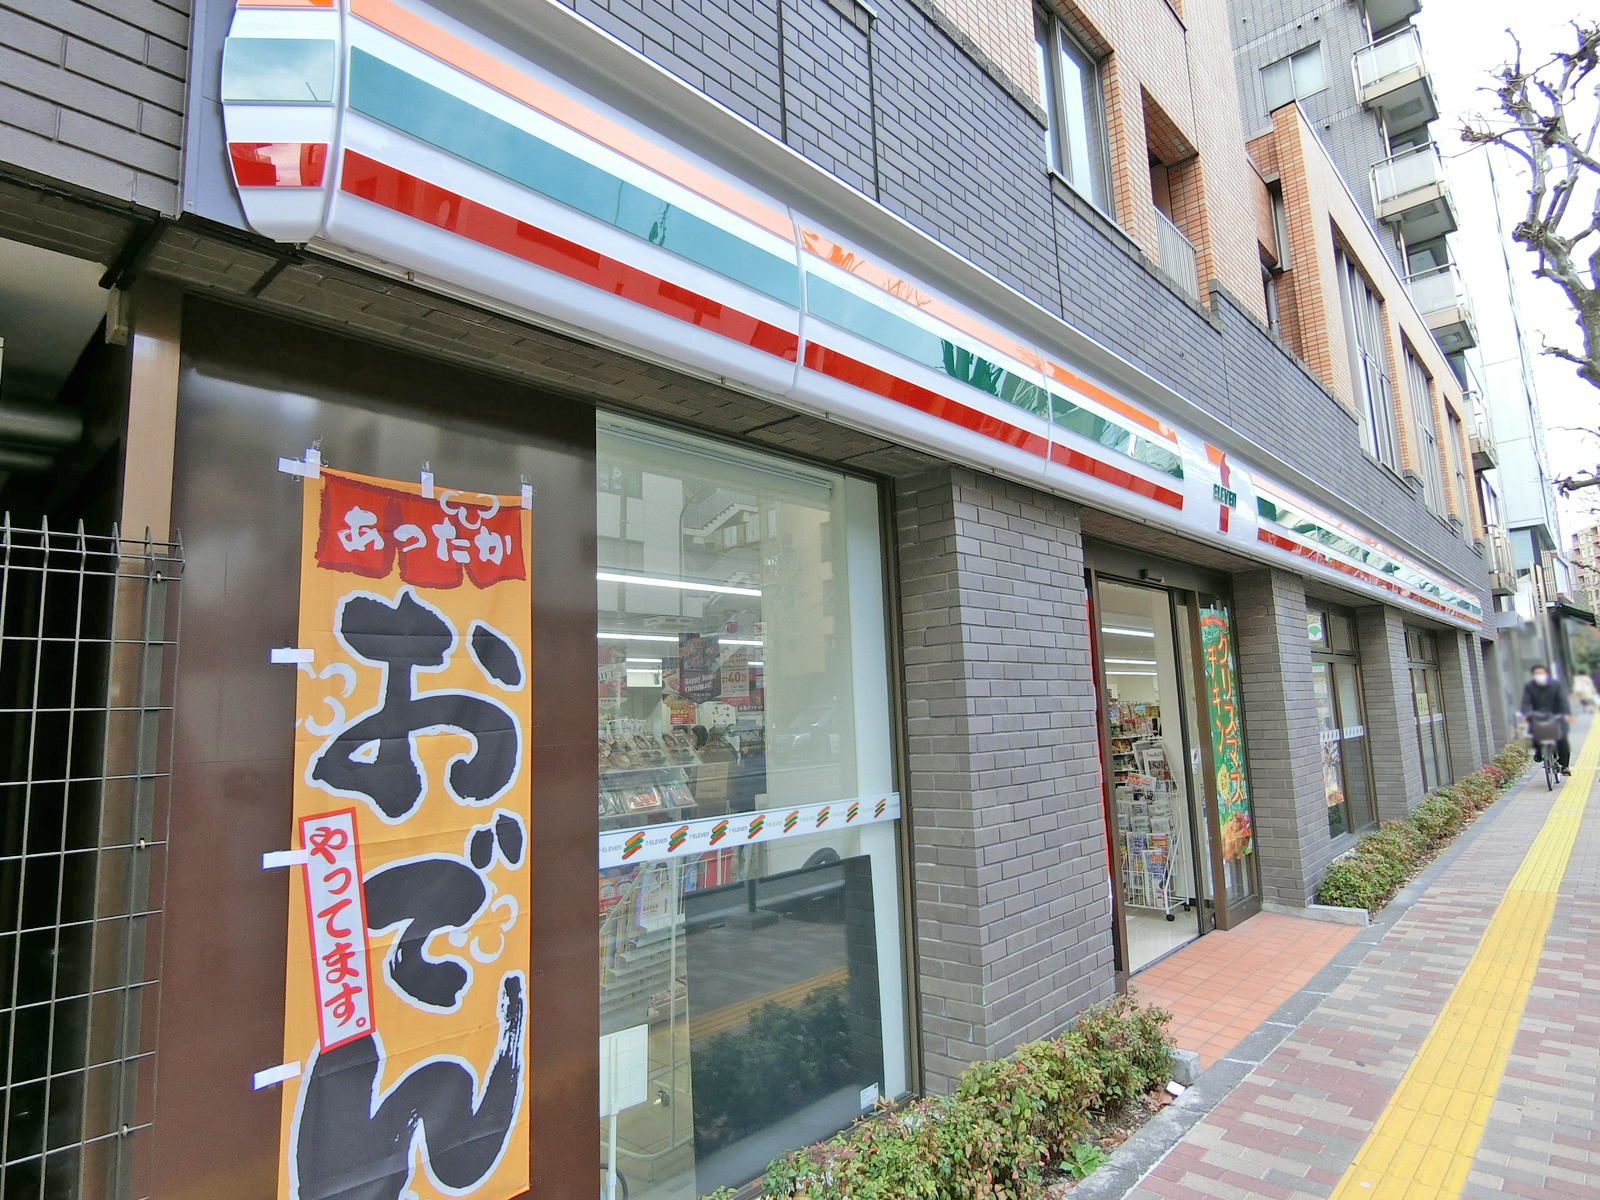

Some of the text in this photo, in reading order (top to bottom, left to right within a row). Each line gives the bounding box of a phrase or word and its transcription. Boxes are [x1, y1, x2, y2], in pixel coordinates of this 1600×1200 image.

[337, 505, 512, 565] あったか
[1205, 645, 1226, 755] チキン
[1217, 630, 1245, 803] クリスマス
[289, 586, 526, 1200] おでん
[308, 825, 367, 1028] やってます。
